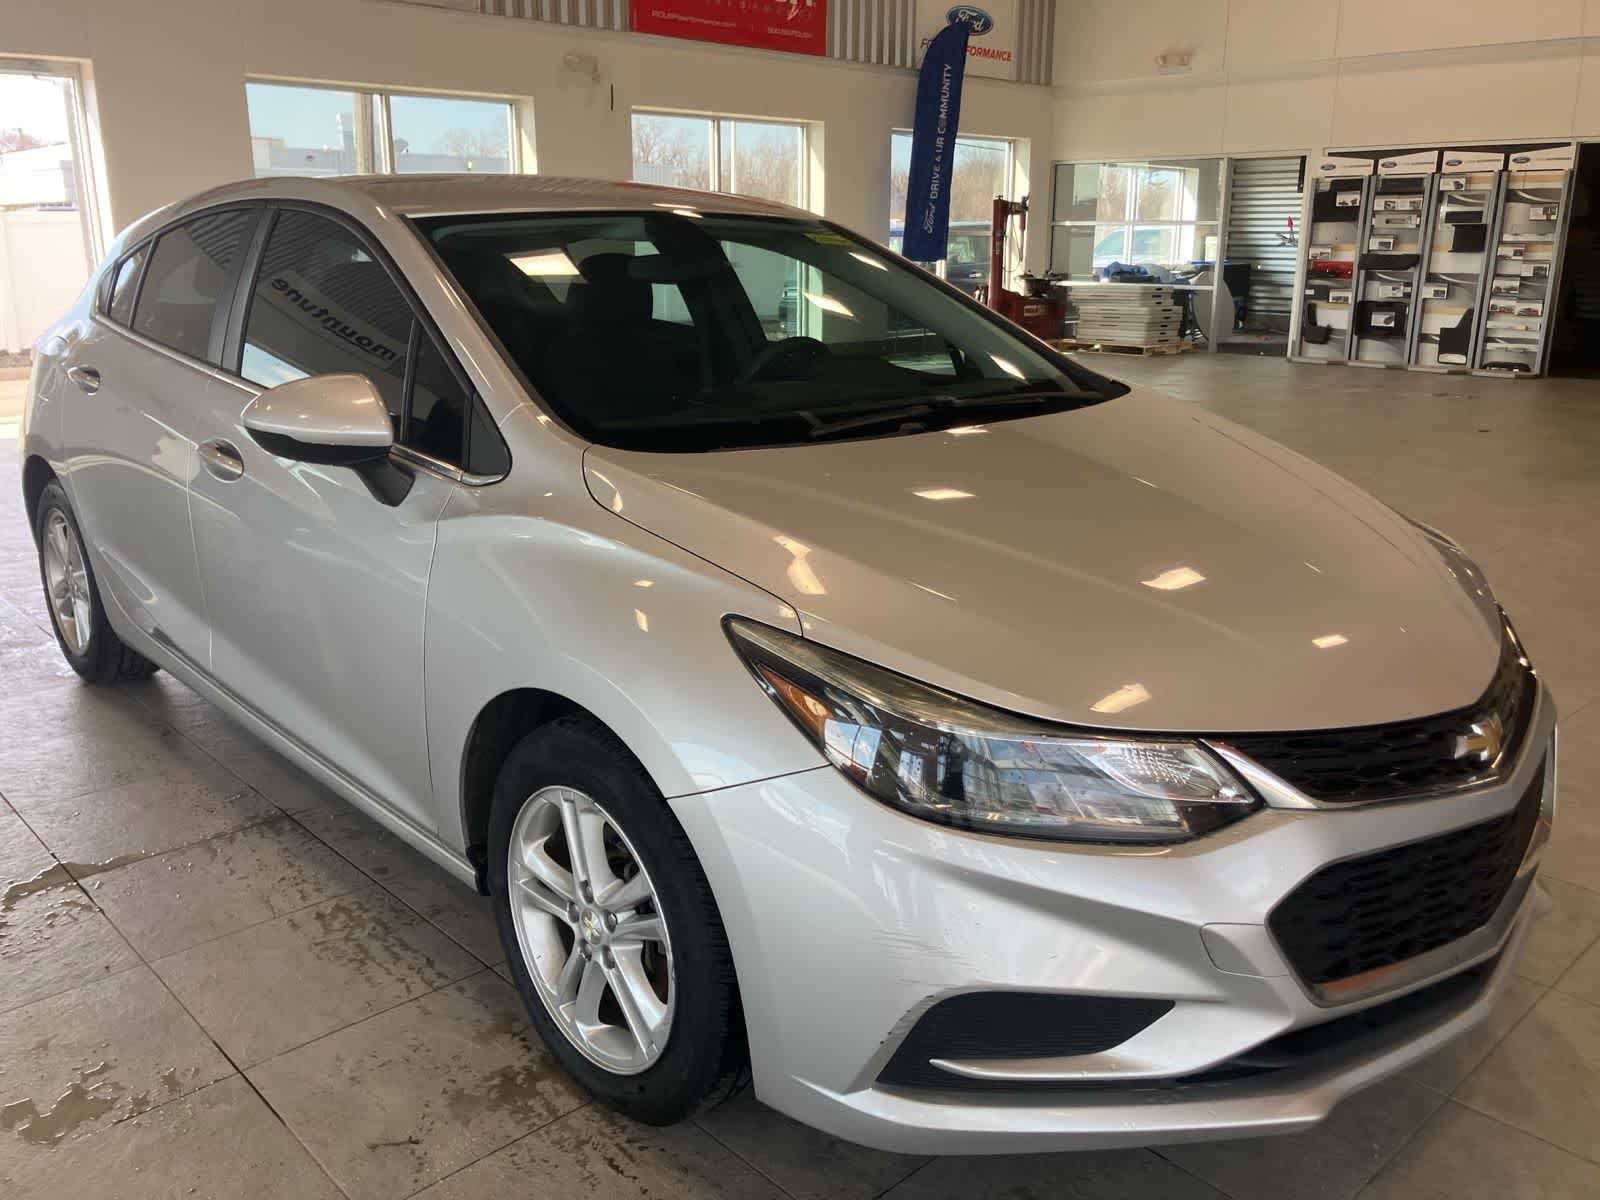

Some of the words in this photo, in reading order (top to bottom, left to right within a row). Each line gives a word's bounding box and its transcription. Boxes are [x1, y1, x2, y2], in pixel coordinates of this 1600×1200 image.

[966, 45, 1012, 61] FORMANCE
[935, 137, 945, 153] UR
[930, 165, 941, 198] DRIVE
[924, 203, 936, 233] Ford
